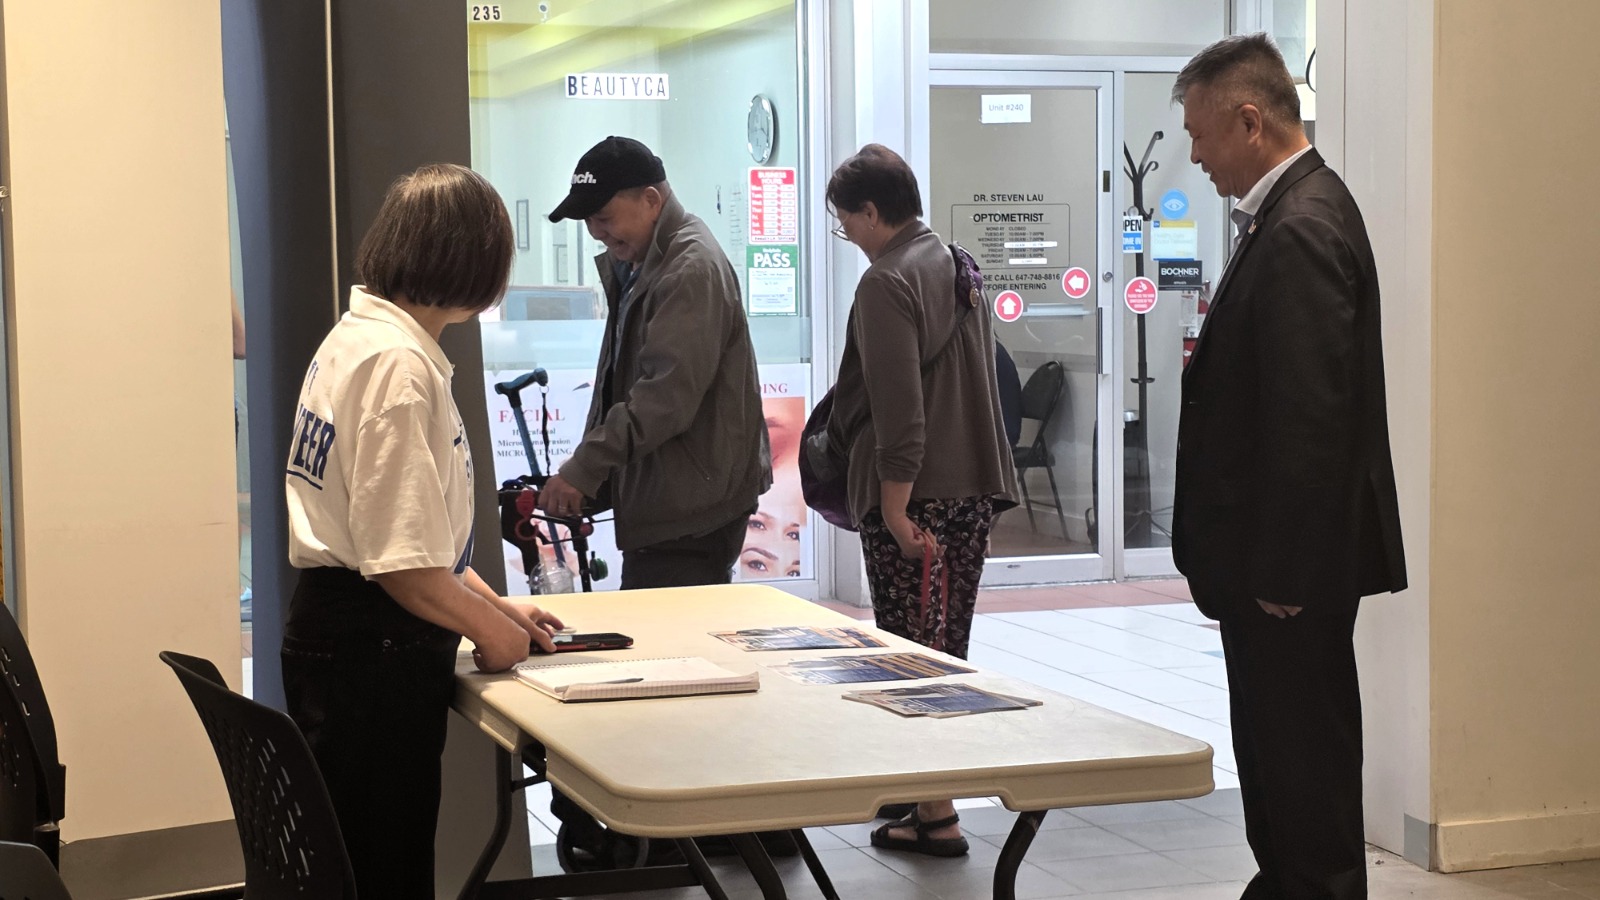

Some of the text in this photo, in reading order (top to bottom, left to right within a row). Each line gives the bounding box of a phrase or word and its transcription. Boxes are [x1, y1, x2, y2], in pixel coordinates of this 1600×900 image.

[473, 5, 500, 20] 235
[568, 76, 666, 96] BEAUTYCA
[973, 213, 1044, 222] OPTOMETRIST
[1123, 220, 1142, 232] PEN
[754, 252, 790, 268] PASS
[1161, 267, 1199, 276] BOCHNER
